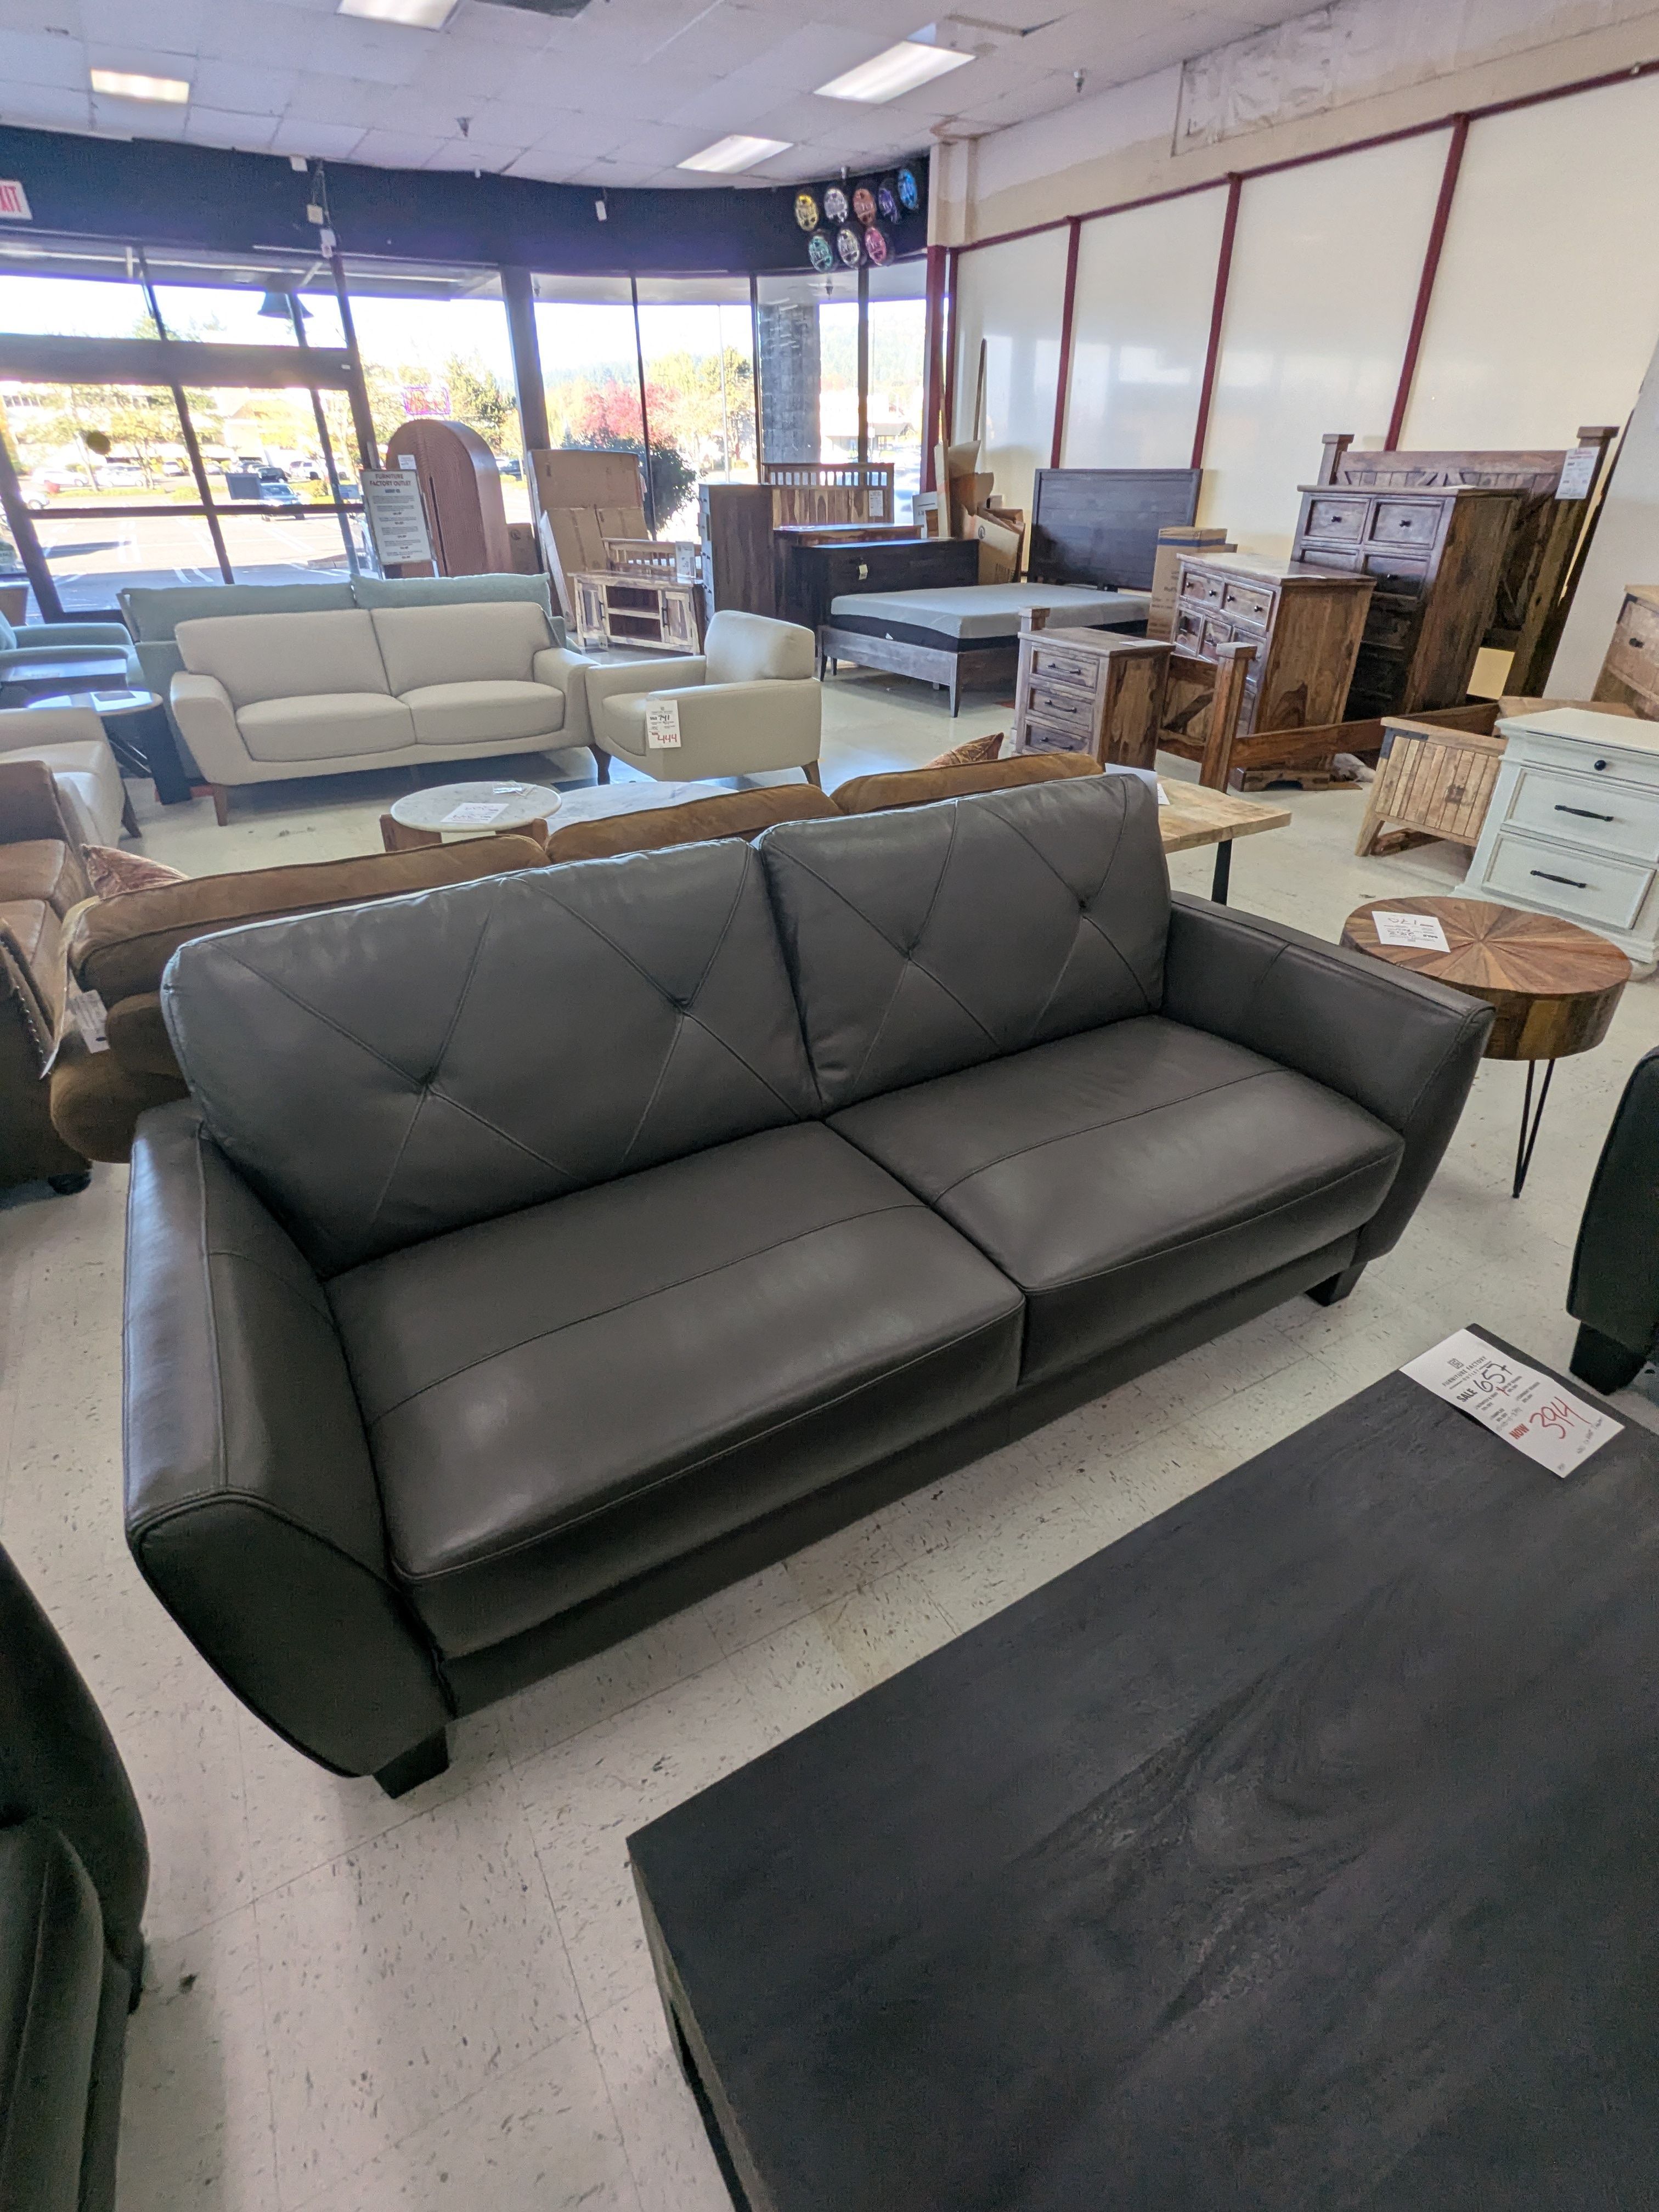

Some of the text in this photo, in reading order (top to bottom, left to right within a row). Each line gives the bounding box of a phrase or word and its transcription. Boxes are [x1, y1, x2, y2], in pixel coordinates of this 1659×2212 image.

[657, 733, 678, 744] 444
[1442, 1356, 1487, 1387] FURNITURE FACTORY
[1456, 1388, 1478, 1402] SALE
[1473, 1363, 1513, 1393] 657
[1462, 1368, 1480, 1381] OUTLET
[1509, 1423, 1530, 1440] NOW
[1530, 1396, 1592, 1440] 394
